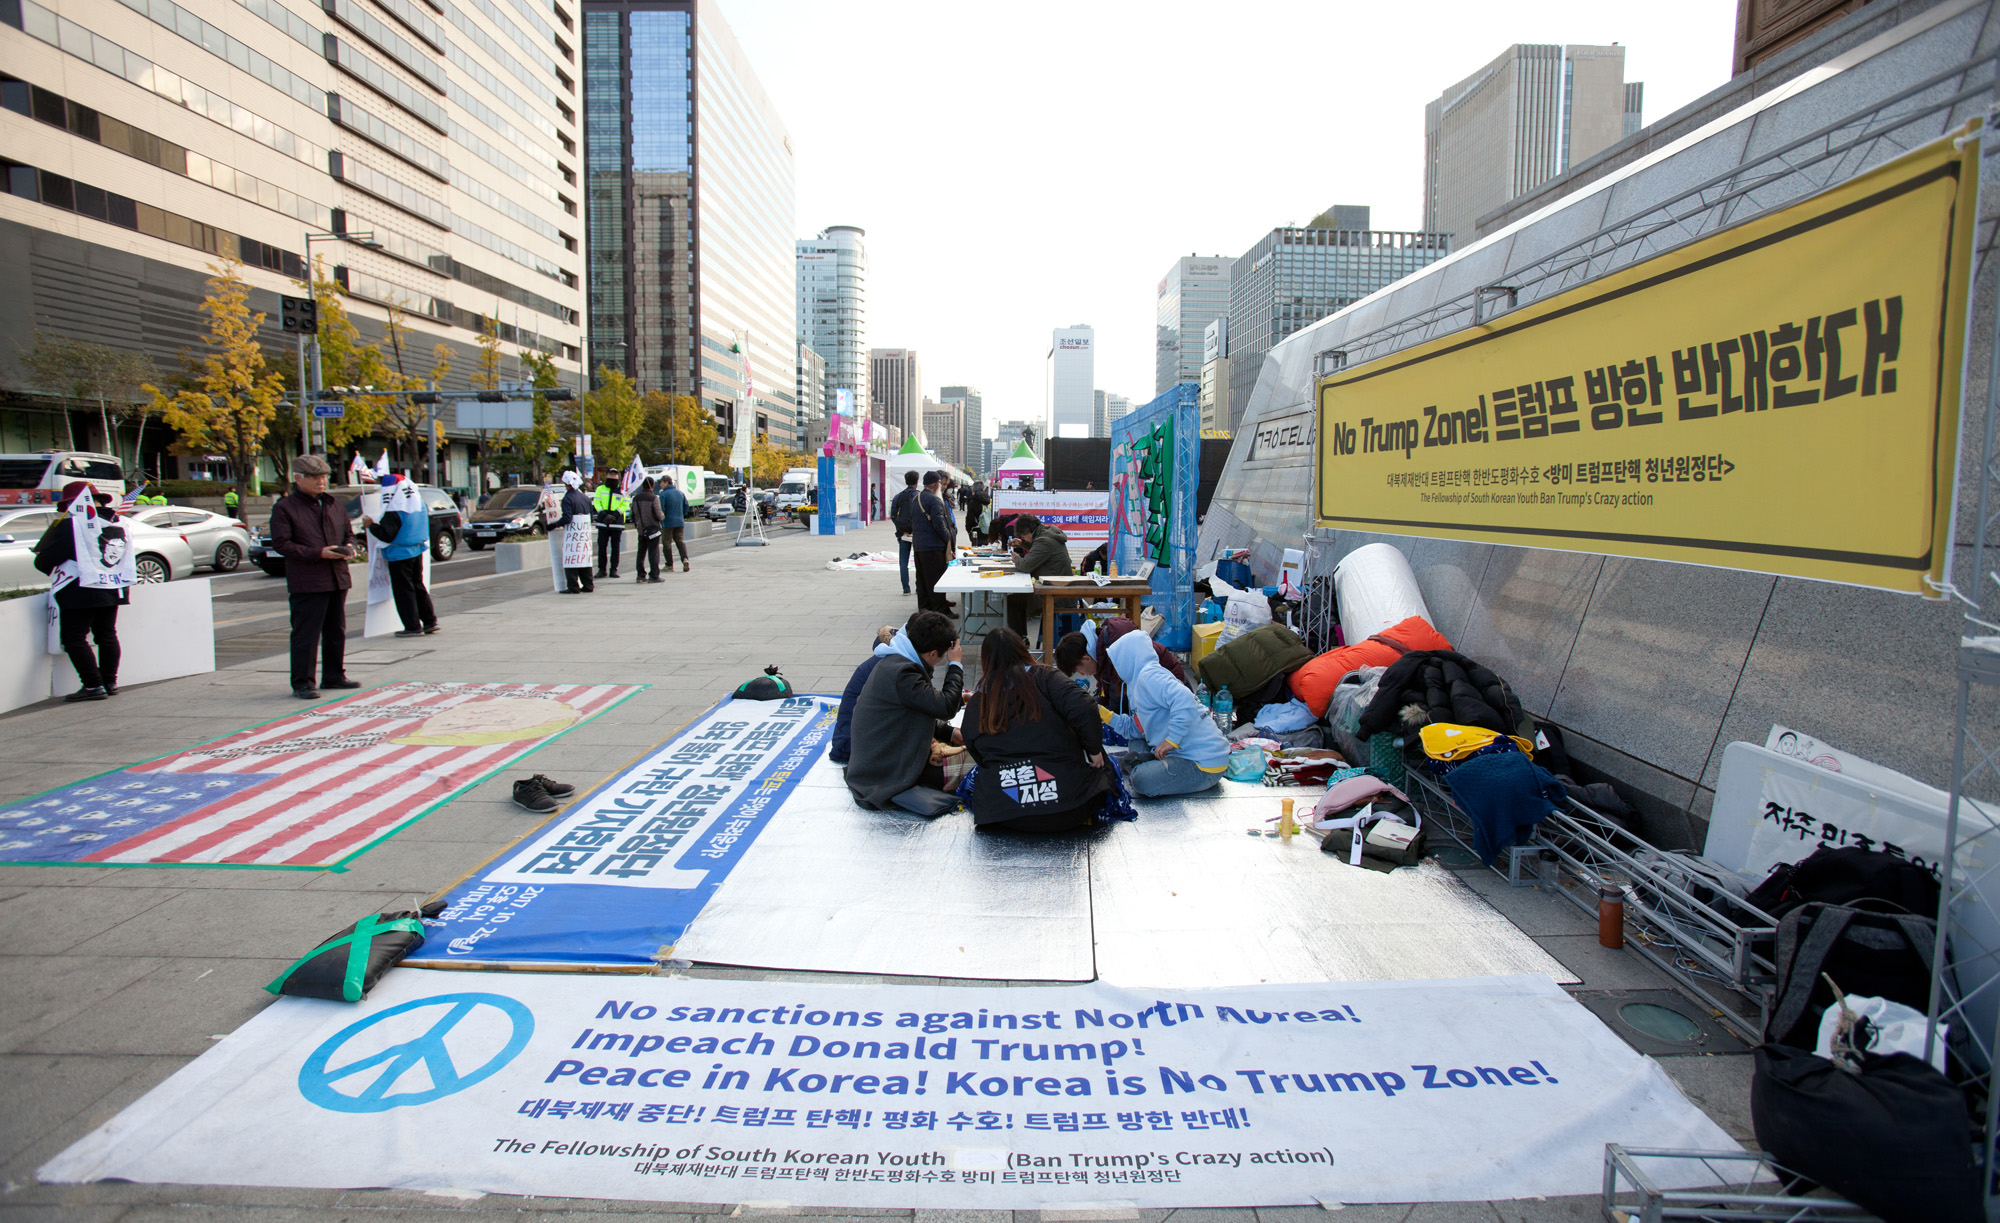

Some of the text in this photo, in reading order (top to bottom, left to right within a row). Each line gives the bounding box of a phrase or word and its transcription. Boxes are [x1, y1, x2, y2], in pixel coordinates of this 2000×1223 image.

[1333, 295, 1903, 459] No Trump Zone! 트럼프 방한 반대한다!
[1386, 454, 1736, 488] 대북제재반대 트럼프탄핵 한반도평화수호 <방미 트럼프탄핵 청년원정단>
[1420, 491, 1653, 509] The Fellowship of South Korean Youth Ban Trump's Crazy action
[566, 522, 590, 532] TRUM
[565, 555, 585, 564] HELP
[769, 697, 816, 718] 방미
[190, 749, 224, 757] die
[251, 743, 355, 756] thousands
[252, 741, 312, 752] going
[754, 771, 792, 796] 트럼프는
[999, 765, 1037, 788] 청춘
[516, 721, 749, 875] 입국 불허 규탄 기자회견
[1019, 780, 1059, 804] 지성
[732, 796, 772, 819] 무엇이
[589, 783, 732, 878] 청년원정단
[1764, 801, 1817, 840] 자주
[700, 819, 752, 859] 두려운가?
[439, 885, 496, 921] 미대사관
[487, 886, 518, 904] 오후
[504, 886, 545, 910] 2017.
[484, 911, 516, 926] 10.
[595, 999, 658, 1021] No
[665, 1002, 883, 1028] sanctions
[894, 1008, 1061, 1035] against
[571, 1027, 1145, 1066] Impeach Donald Trump!
[544, 1059, 1560, 1097] Peace in Korea! Korea is No Trump Zone!
[517, 1098, 1253, 1132] 대북제재 중단! 트럼프 탄핵! 평화 수호! 트럼프 방한 반대!
[492, 1138, 1336, 1172] The Fellowship of South Korean Youth (Ban Trump's Crazy action)
[633, 1161, 1182, 1185] 대북제재반대 트럼프탄핵 한반도평화수호 방미 트럼프탄핵 청년원정단
